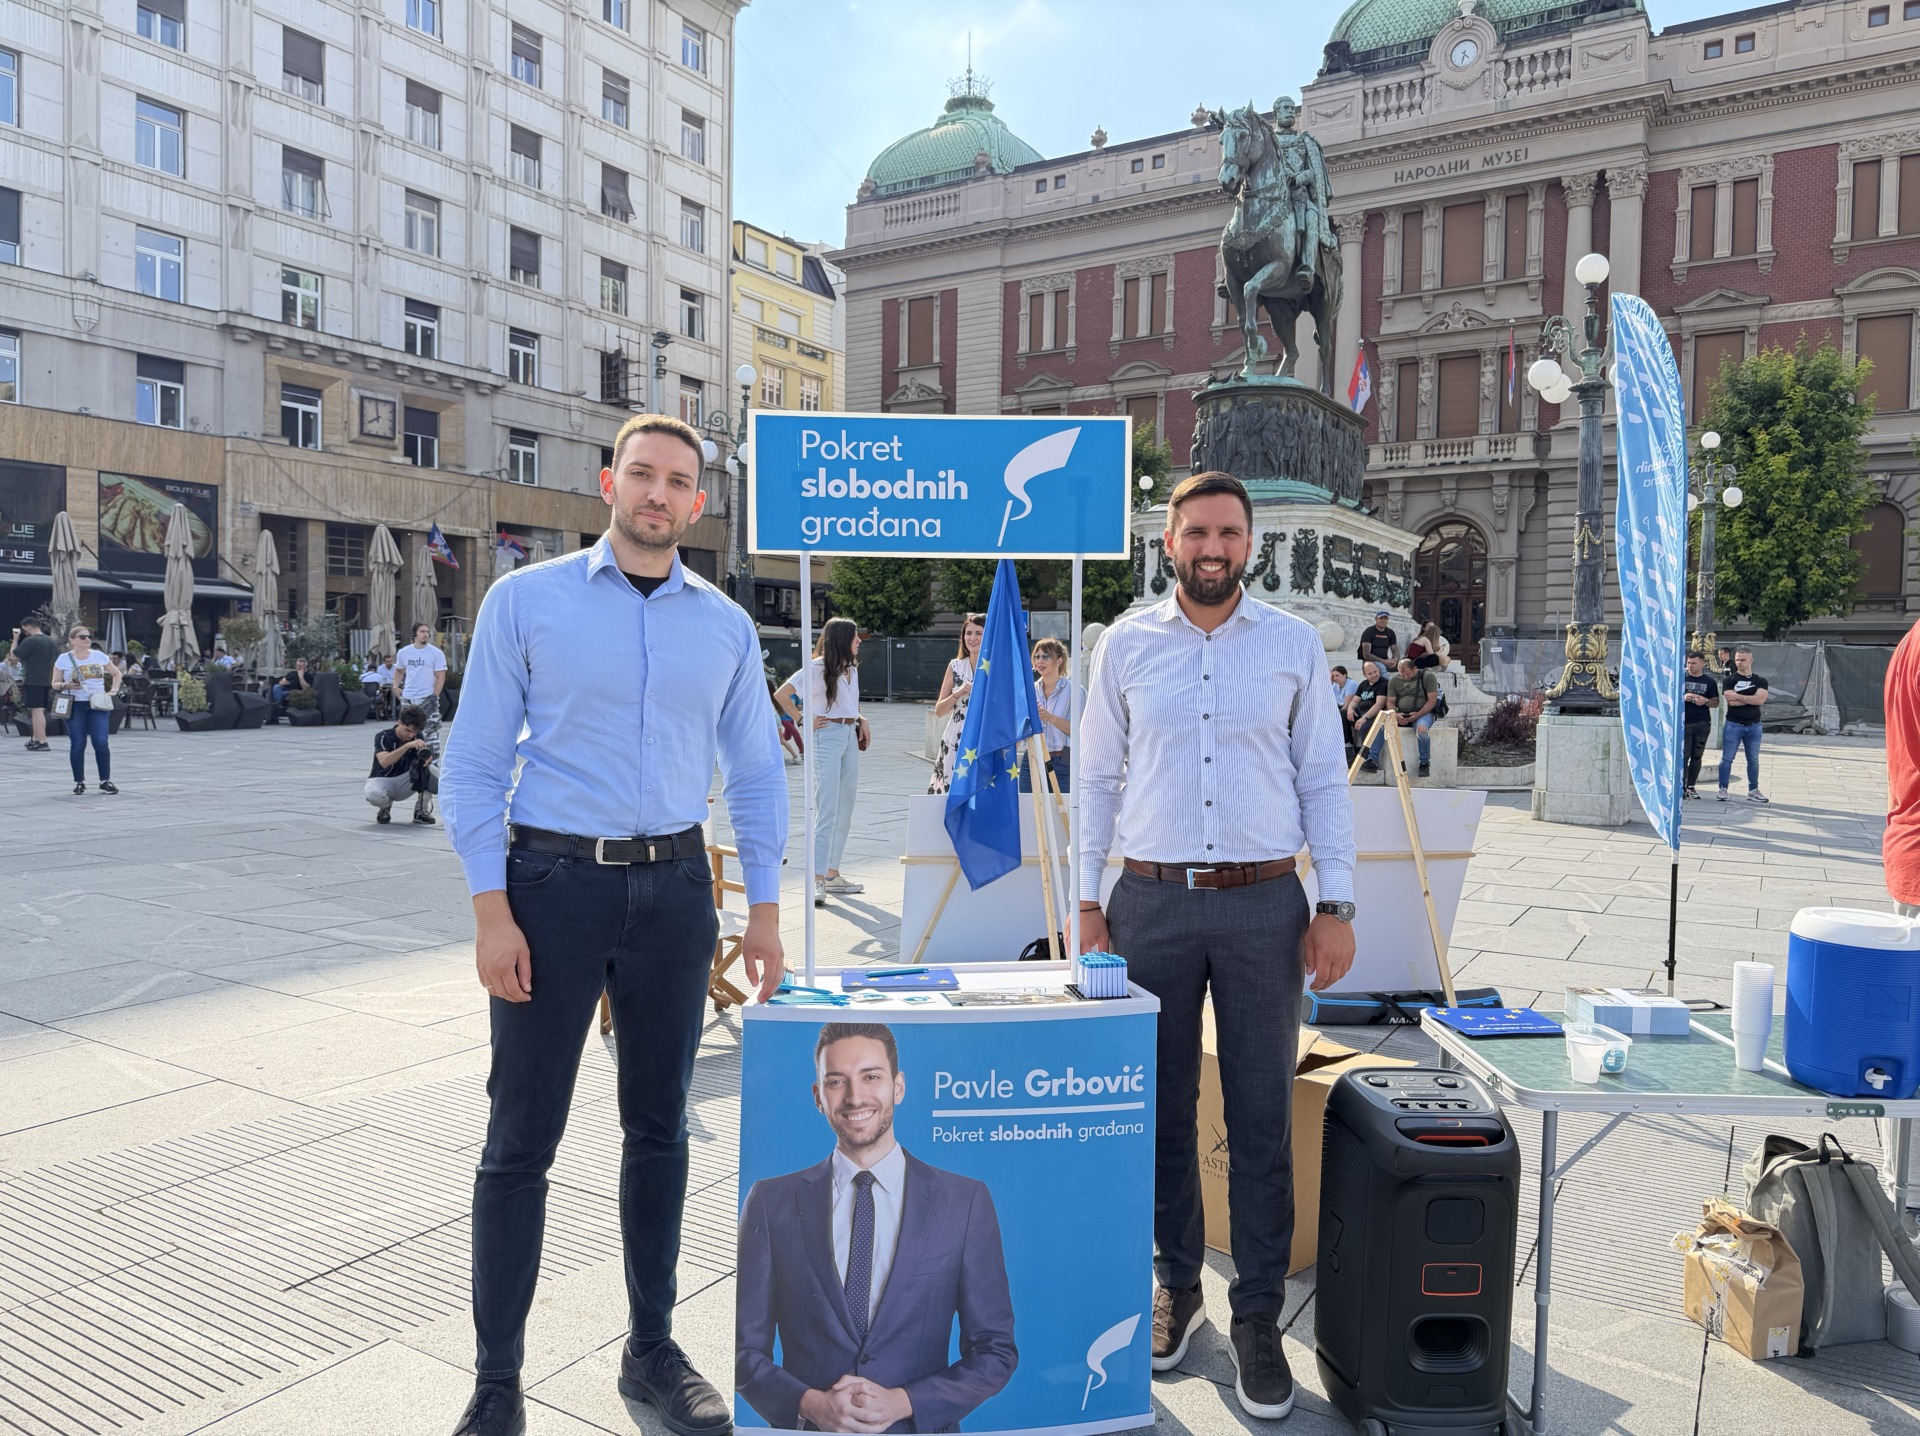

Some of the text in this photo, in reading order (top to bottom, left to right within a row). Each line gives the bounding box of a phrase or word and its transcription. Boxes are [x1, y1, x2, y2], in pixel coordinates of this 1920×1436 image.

[1394, 147, 1529, 184] НАРОДНИ МУЗЕЈ
[801, 429, 903, 462] Pokret
[800, 467, 969, 500] slobodnih
[801, 506, 942, 545] građana
[934, 1064, 1145, 1100] Pavle Grbović
[932, 1119, 1144, 1143] Pokret slobodnih građana
